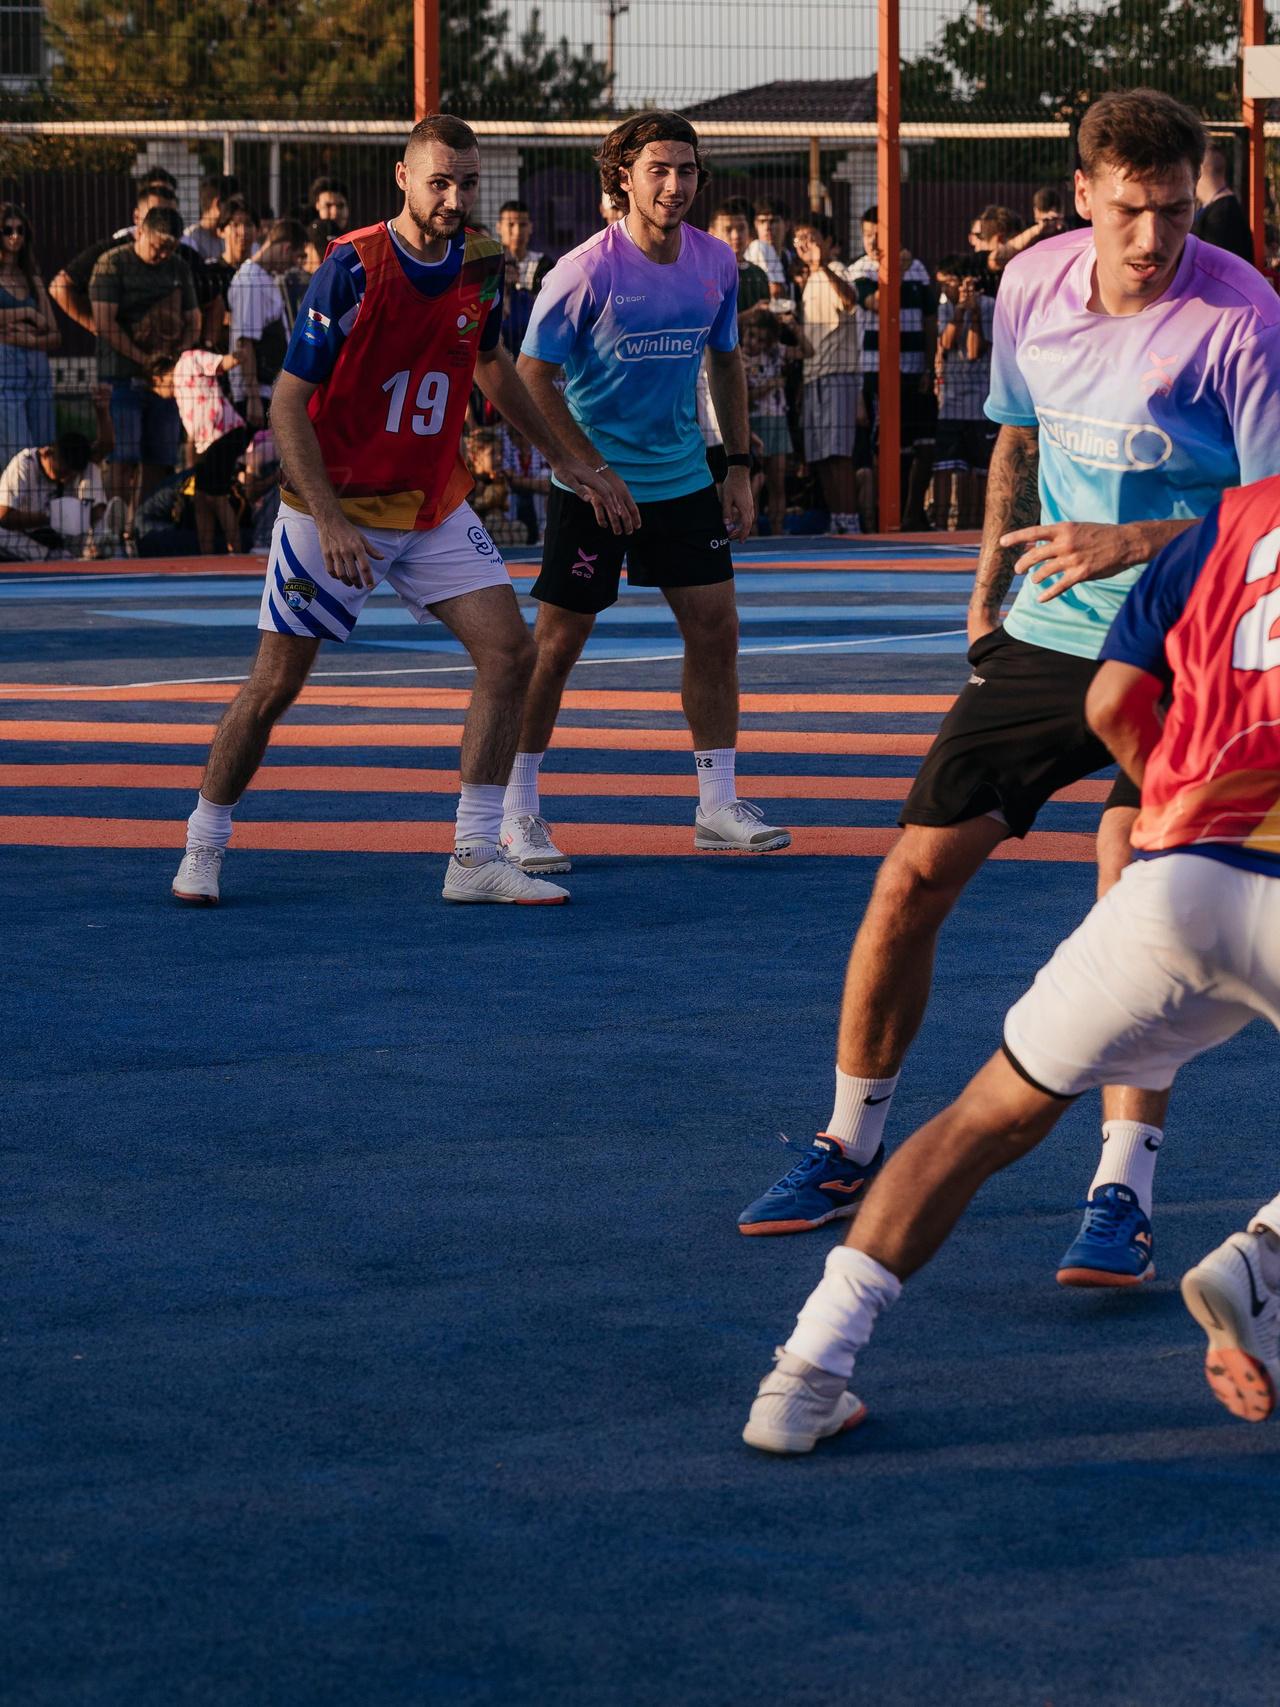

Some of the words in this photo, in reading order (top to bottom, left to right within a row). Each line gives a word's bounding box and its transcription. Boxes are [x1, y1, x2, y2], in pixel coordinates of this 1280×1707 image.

[625, 295, 647, 303] EQPT
[625, 335, 693, 355] Winline
[381, 369, 450, 436] 19
[571, 569, 583, 577] FC
[695, 757, 714, 768] 23
